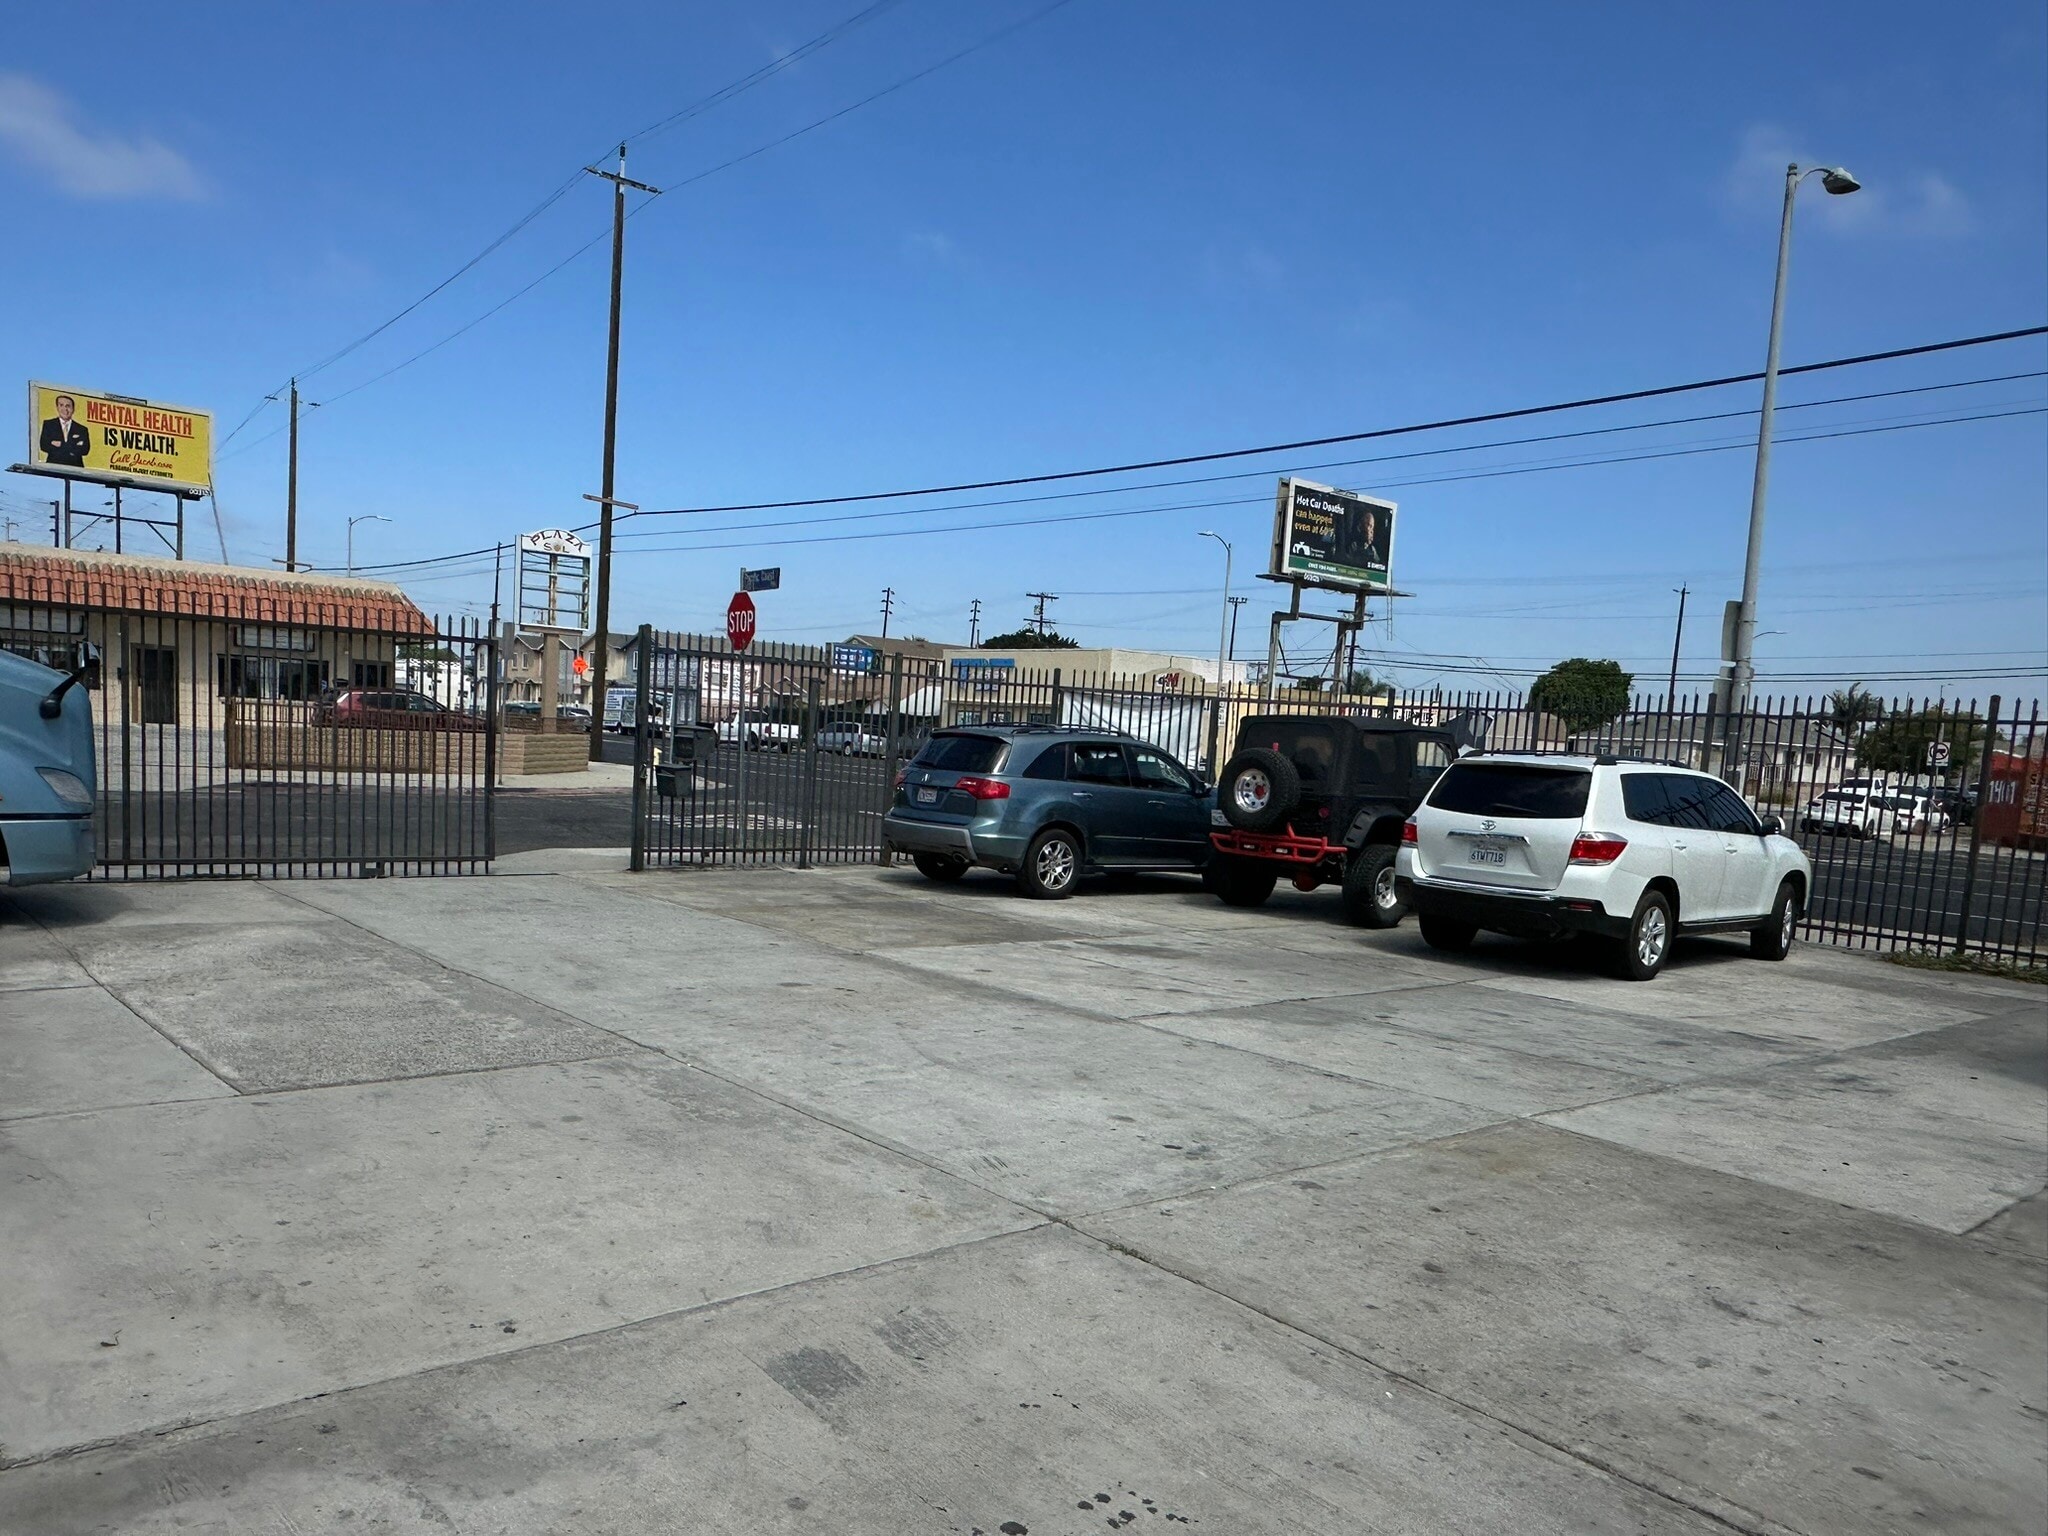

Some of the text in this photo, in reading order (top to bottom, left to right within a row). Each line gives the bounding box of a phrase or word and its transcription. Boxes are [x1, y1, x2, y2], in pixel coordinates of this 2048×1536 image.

[86, 401, 192, 435] MENTAL HEALTH
[104, 427, 178, 456] IS WEALTH.
[1296, 495, 1344, 515] Hot Car Deaths
[531, 530, 582, 552] PLAZA
[729, 610, 753, 633] STOP
